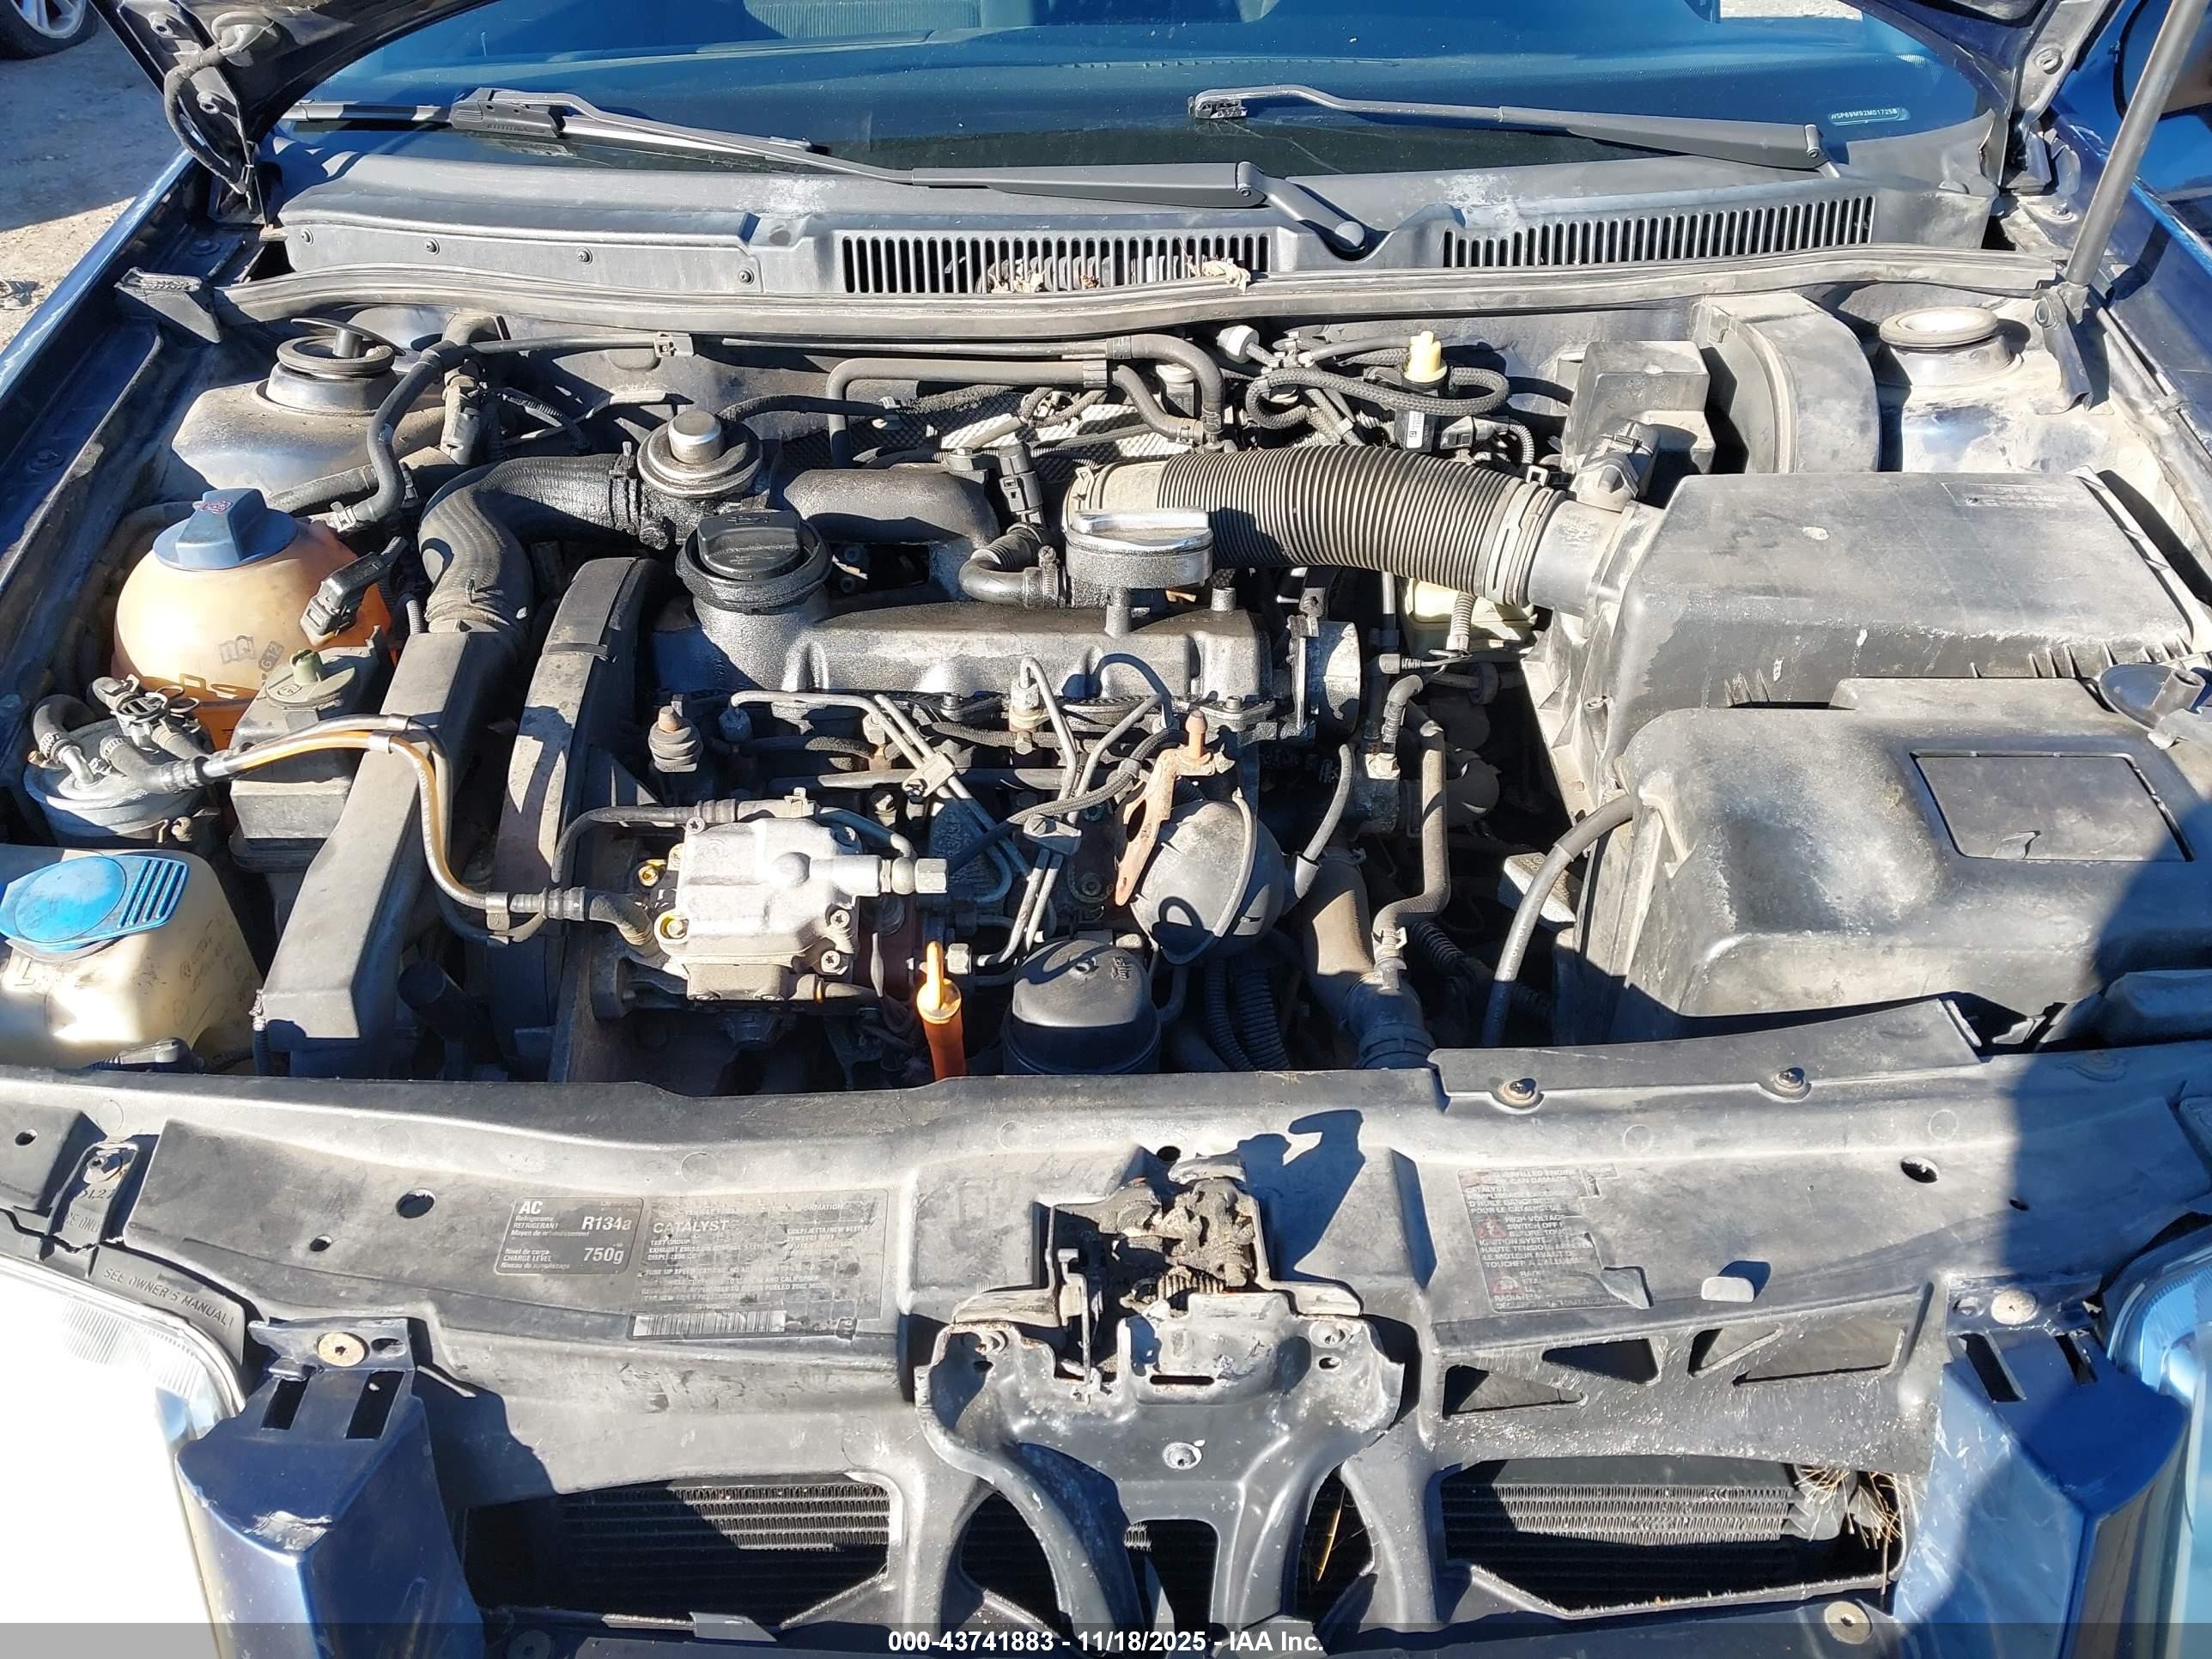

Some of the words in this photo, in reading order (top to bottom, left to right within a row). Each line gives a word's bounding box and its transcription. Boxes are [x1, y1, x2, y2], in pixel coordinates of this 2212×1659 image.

[518, 1200, 544, 1215] AC
[581, 1215, 633, 1231] R134a
[653, 1219, 730, 1234] CATALYST
[583, 1247, 624, 1265] 750g
[104, 1267, 125, 1284] SEE
[128, 1276, 180, 1302] OWNER'S
[181, 1295, 230, 1327] MANUAL
